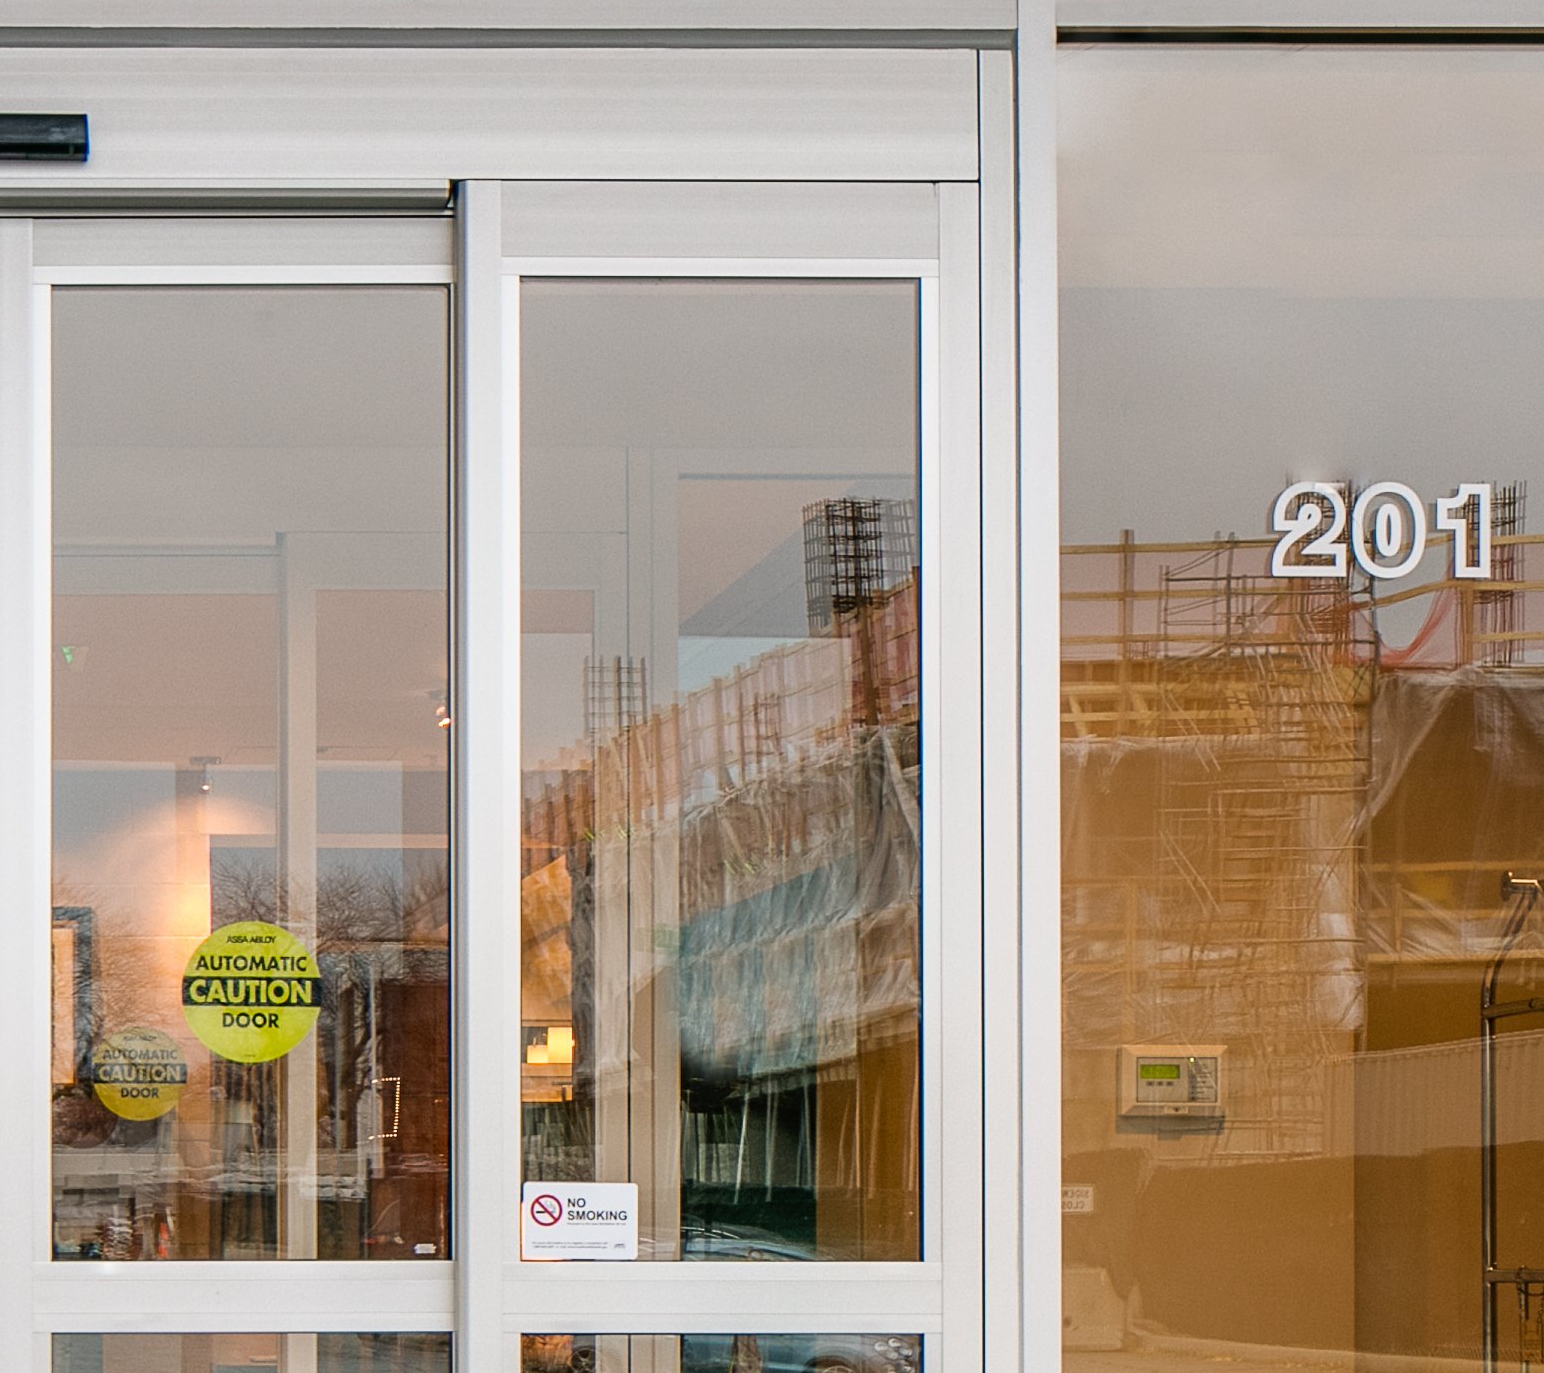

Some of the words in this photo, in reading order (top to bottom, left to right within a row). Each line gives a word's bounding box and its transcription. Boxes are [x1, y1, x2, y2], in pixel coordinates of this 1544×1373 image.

[1271, 481, 1491, 578] 201
[226, 935, 248, 944] ASSA
[250, 935, 277, 944] ABLOY
[195, 955, 307, 972] AUTOMATIC
[189, 979, 312, 1004] CAUTION
[222, 1013, 279, 1028] DOOR
[103, 1049, 178, 1060] AUTOMATIC
[99, 1065, 180, 1082] CAUTION
[121, 1088, 159, 1098] DOOR
[567, 1197, 586, 1208] NO
[567, 1210, 628, 1221] SMOKING
